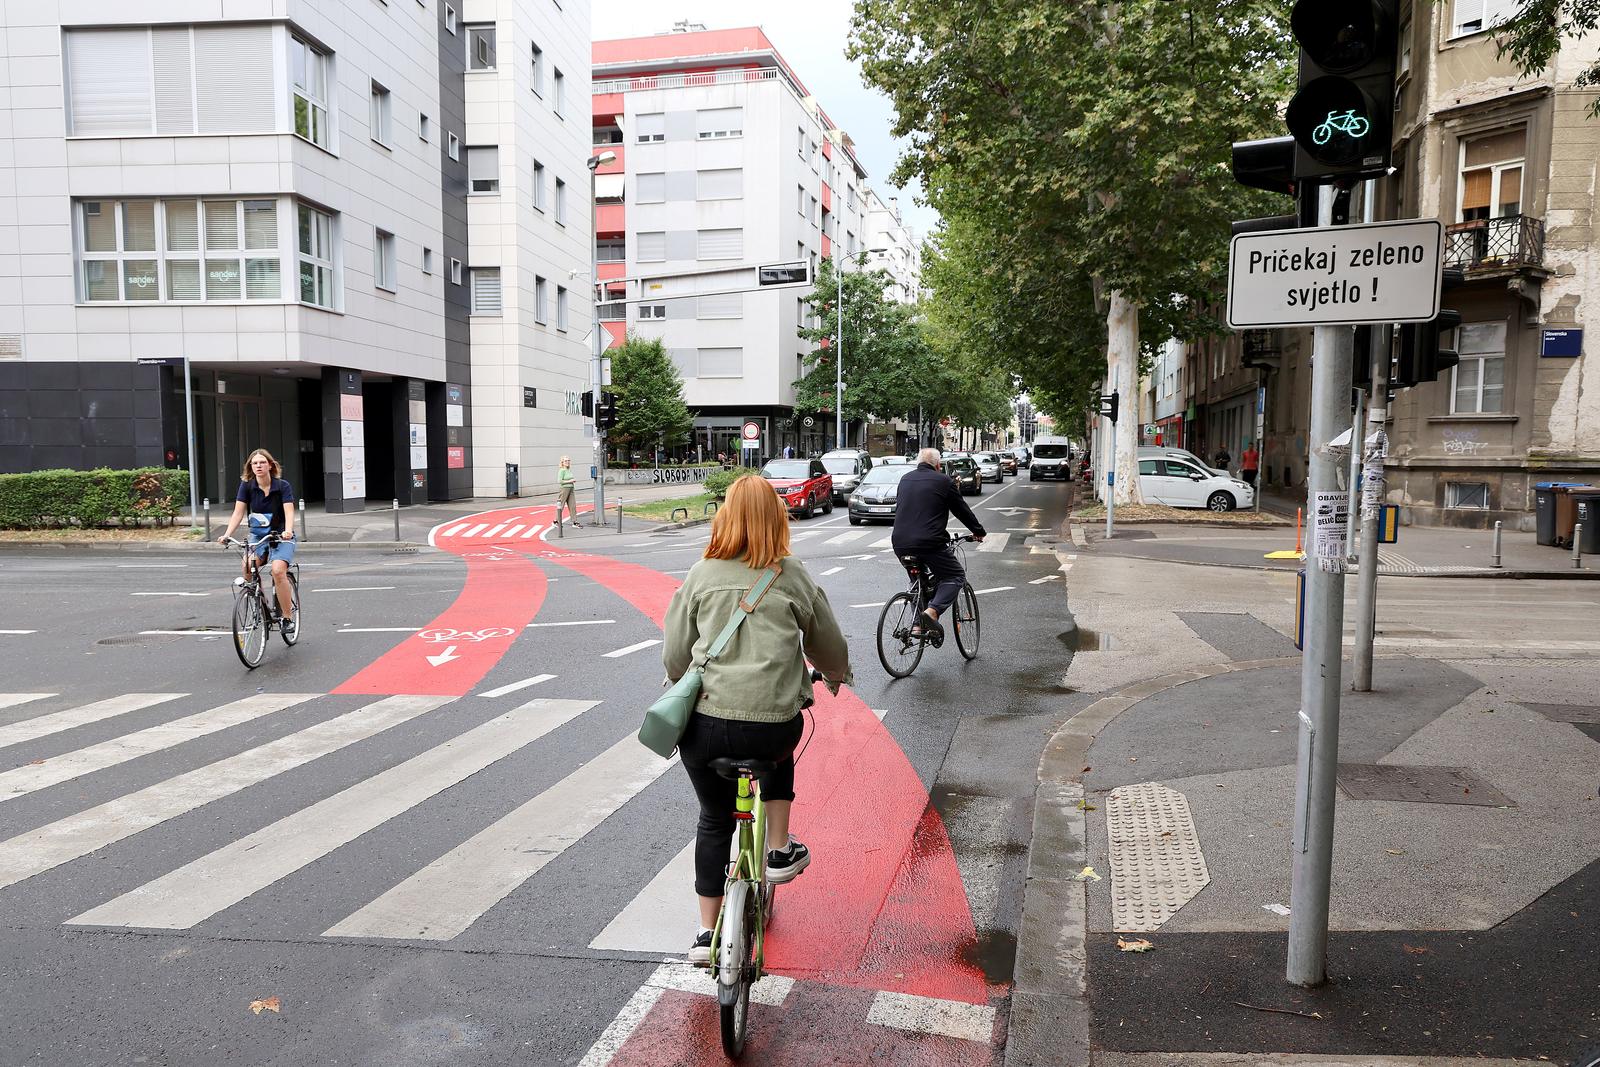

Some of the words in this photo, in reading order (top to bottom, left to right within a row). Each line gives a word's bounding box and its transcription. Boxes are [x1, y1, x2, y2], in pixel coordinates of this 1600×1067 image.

[1249, 244, 1336, 275] Pričekaj
[1349, 241, 1424, 267] zeleno
[1286, 278, 1360, 311] svjetlo
[1371, 277, 1379, 302] !
[653, 469, 690, 483] SLOBODA
